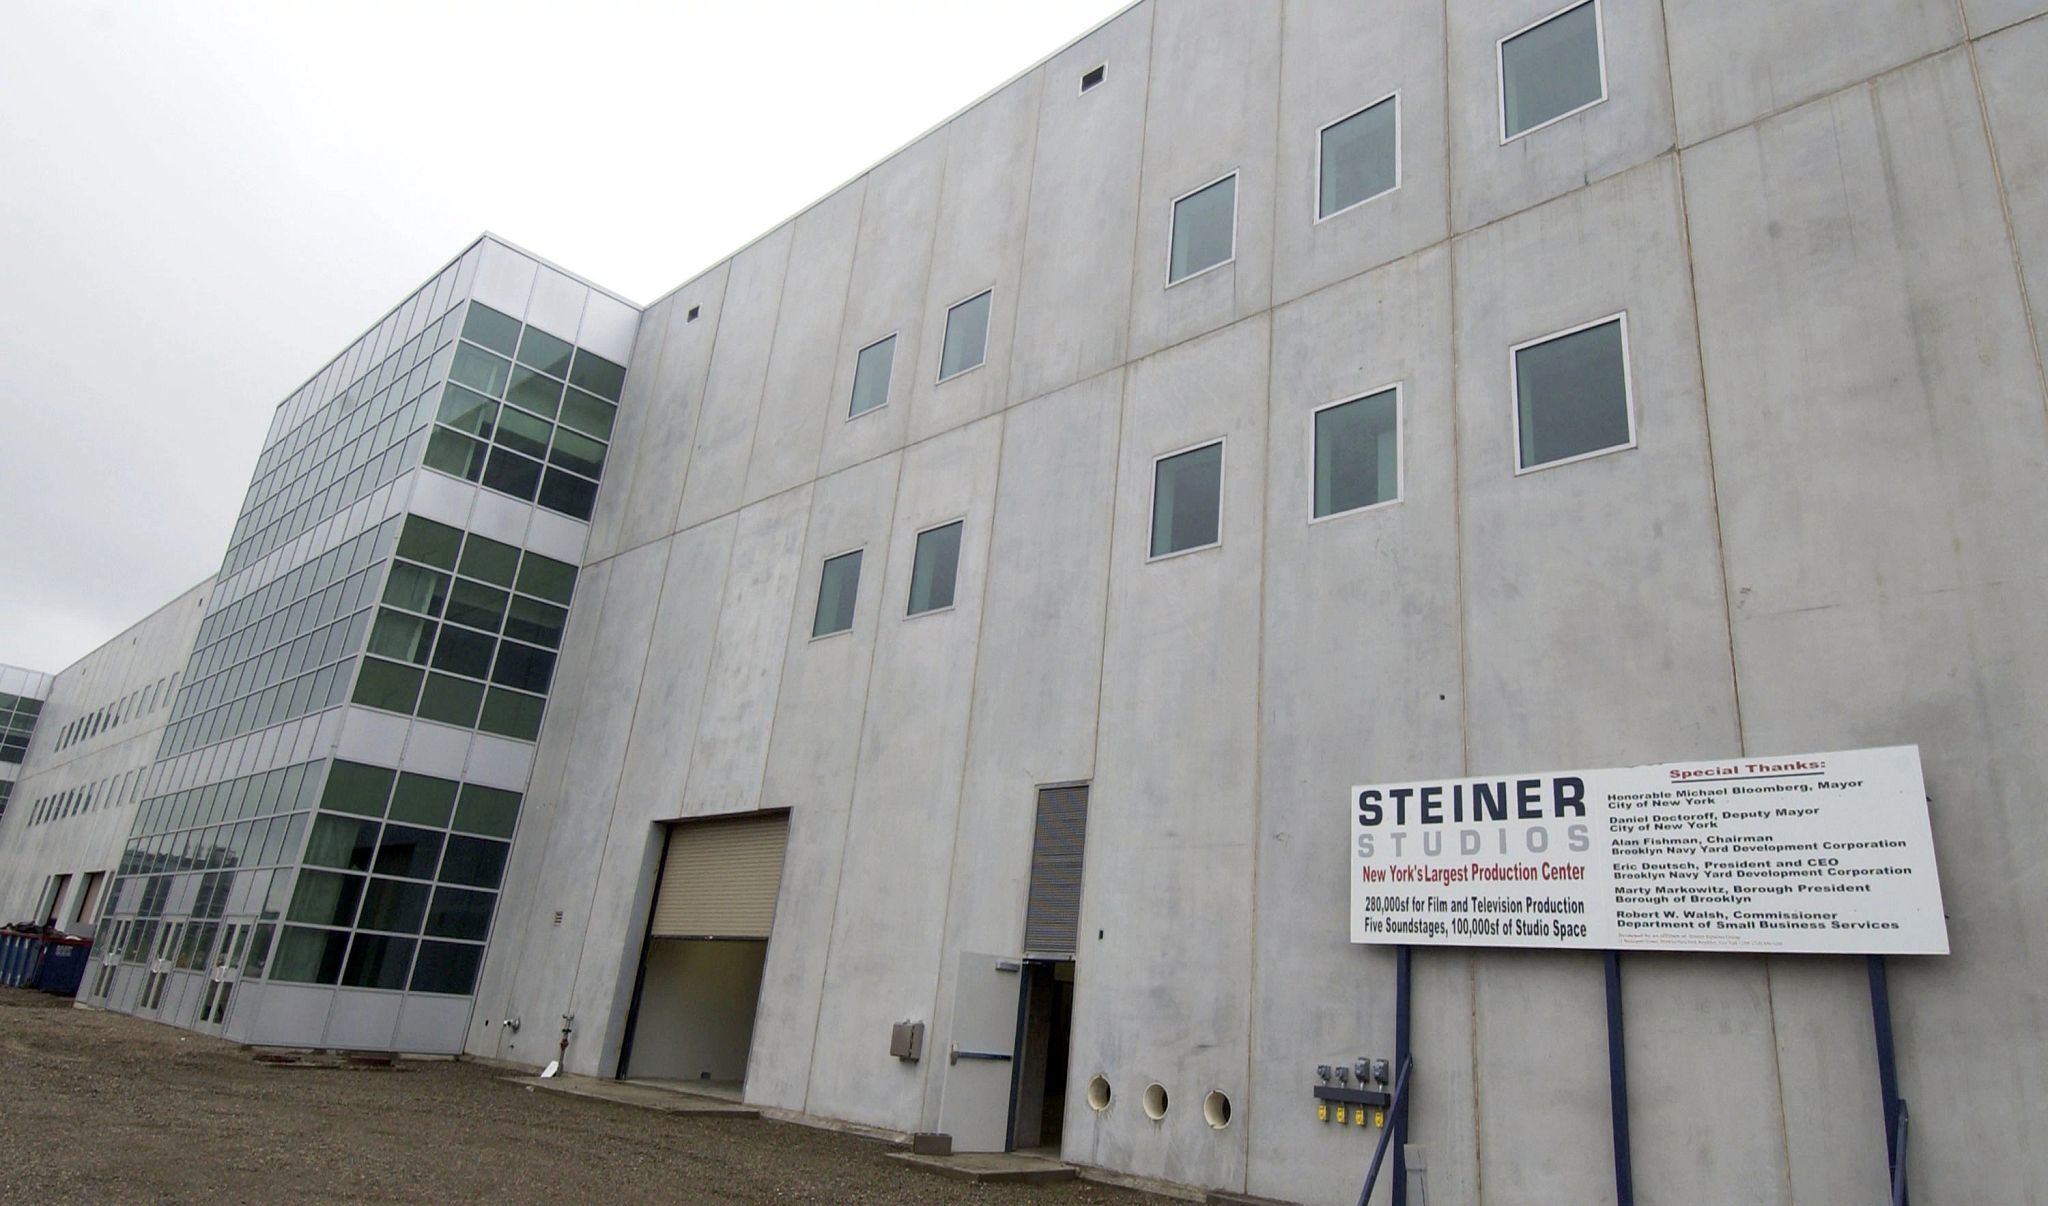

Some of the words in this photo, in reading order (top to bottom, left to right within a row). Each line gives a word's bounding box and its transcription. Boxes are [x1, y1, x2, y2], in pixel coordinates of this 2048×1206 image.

[1670, 766, 1738, 779] Special
[1746, 761, 1825, 772] Thanks:
[1608, 791, 1671, 801] Honorable
[1676, 788, 1727, 797] Michael
[1733, 784, 1813, 794] Bloomberg,
[1818, 780, 1863, 790] Mayor
[1359, 777, 1586, 826] STEINER
[1608, 801, 1632, 810] City
[1686, 797, 1715, 805] York
[1610, 816, 1648, 824] Daniel
[1653, 813, 1717, 822] Doctoroff,
[1723, 809, 1770, 820] Deputy
[1776, 807, 1820, 817] Mayor
[1610, 824, 1633, 833] City
[1688, 821, 1718, 829] York
[1358, 825, 1590, 858] STUDIOS
[1707, 835, 1773, 843] Chairman
[1612, 848, 1662, 856] Brooklyn
[1667, 847, 1696, 855] Navy
[1733, 844, 1818, 853] Development
[1823, 840, 1906, 851] Corporation
[1642, 862, 1699, 870] Deutsch,
[1705, 860, 1771, 869] President
[1808, 858, 1839, 866] CEO
[1363, 866, 1386, 882] New
[1390, 865, 1423, 882] York's
[1425, 865, 1468, 886] Largest
[1472, 863, 1537, 881] Production
[1542, 862, 1585, 880] Center
[1614, 872, 1665, 880] Brooklyn
[1737, 869, 1823, 878] Development
[1828, 867, 1912, 877] Corporation
[1615, 887, 1650, 895] Marty
[1656, 886, 1728, 894] Markowitz,
[1734, 885, 1792, 894] Borough
[1798, 884, 1871, 893] President
[1365, 897, 1409, 915] 280,000sf
[1412, 897, 1424, 912] for
[1428, 897, 1448, 912] Film
[1451, 897, 1468, 913] and
[1471, 897, 1522, 913] Television
[1526, 897, 1584, 913] Production
[1616, 896, 1669, 904] Borough
[1674, 895, 1686, 903] of
[1691, 895, 1752, 904] Brooklyn
[1617, 911, 1659, 919] Robert
[1683, 911, 1728, 920] Walsh,
[1733, 910, 1838, 919] Commissioner
[1365, 918, 1383, 933] Five
[1386, 918, 1448, 938] Soundstages,
[1451, 919, 1499, 938] 100,000sf
[1503, 919, 1512, 936] of
[1516, 919, 1549, 936] Studio
[1553, 920, 1586, 941] Space
[1617, 920, 1694, 929] Department
[1717, 921, 1755, 929] Small
[1760, 921, 1826, 929] Business
[1831, 921, 1899, 929] Services
